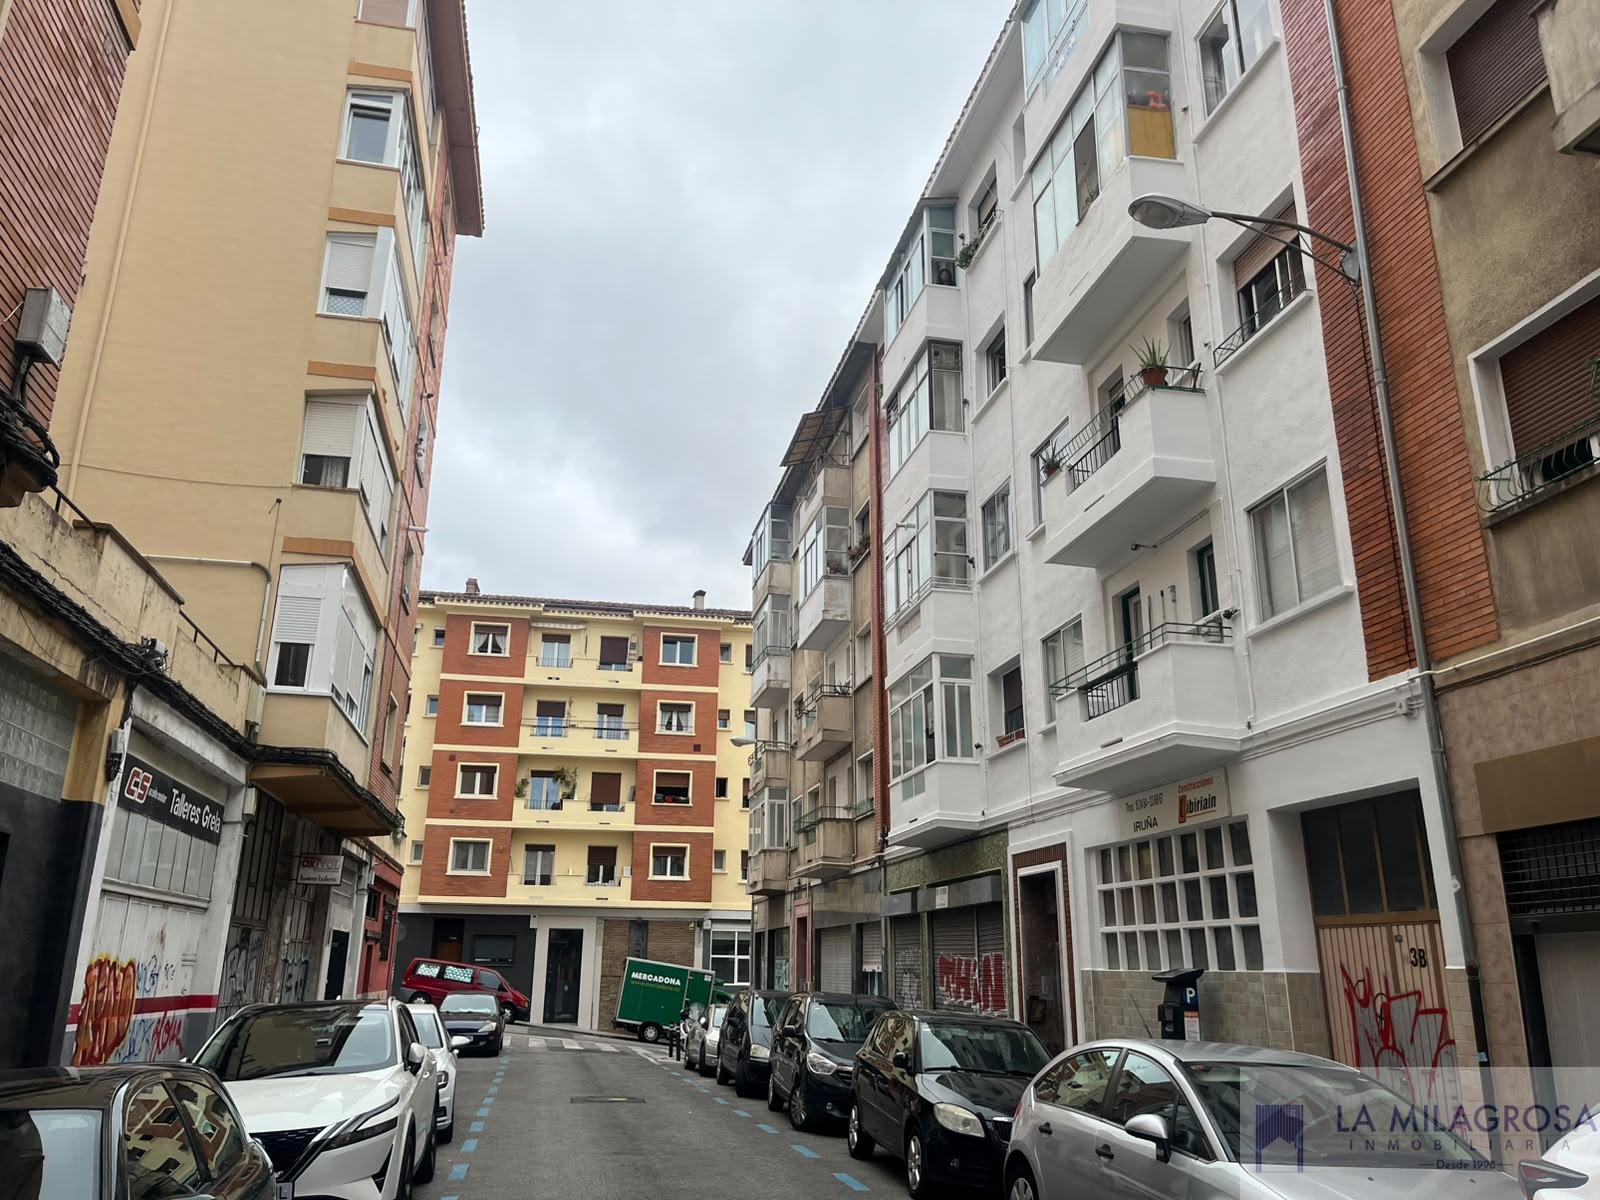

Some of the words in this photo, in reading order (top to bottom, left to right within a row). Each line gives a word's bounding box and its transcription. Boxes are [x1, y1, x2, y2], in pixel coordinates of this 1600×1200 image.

[169, 788, 201, 825] Talleres
[201, 805, 221, 834] Grela
[1133, 816, 1158, 832] IRUÑA
[1409, 947, 1428, 968] 3B
[631, 971, 681, 985] MERCADONA
[1185, 987, 1196, 1004] P
